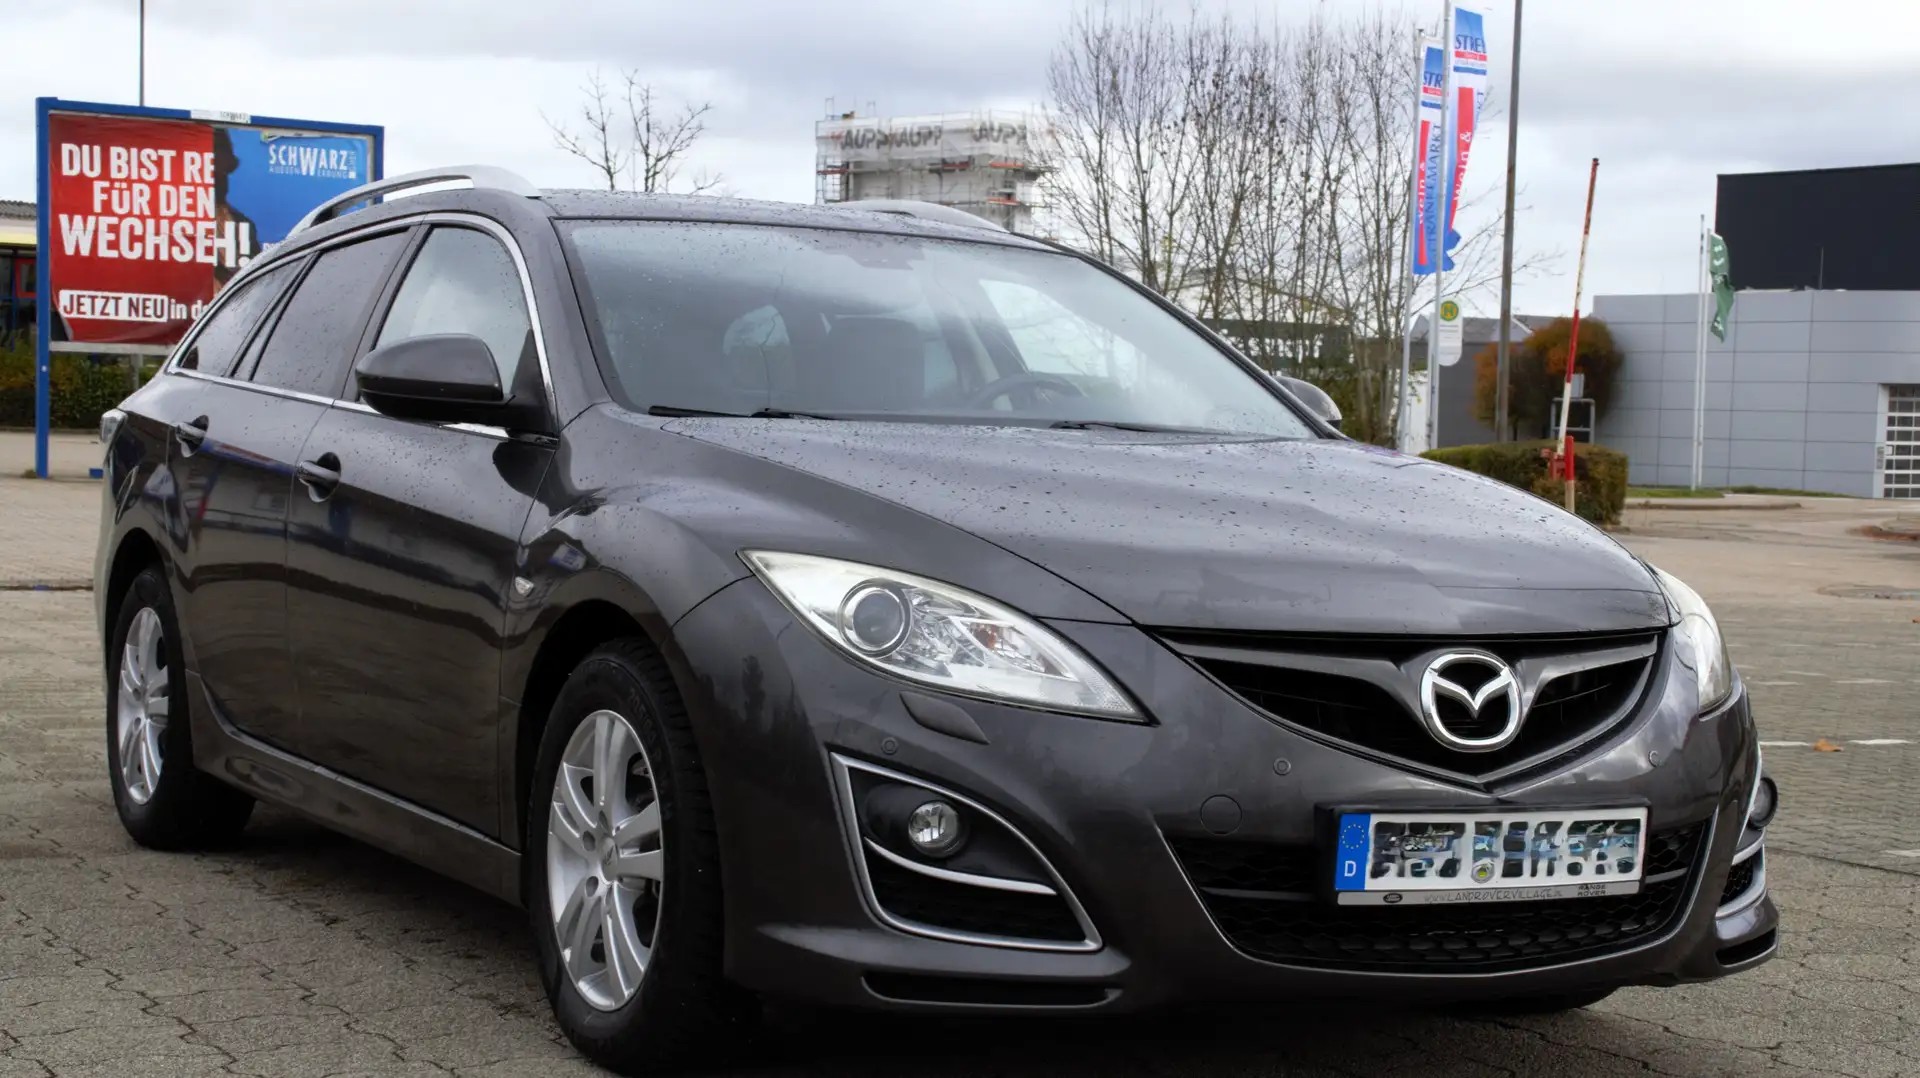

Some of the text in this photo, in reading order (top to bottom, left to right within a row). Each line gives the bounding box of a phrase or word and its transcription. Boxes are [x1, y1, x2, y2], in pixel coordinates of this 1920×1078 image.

[61, 143, 215, 184] DU BIST RE
[269, 144, 348, 176] SCHWARZ
[159, 184, 215, 218] DEN
[64, 294, 122, 317] JETZT
[128, 297, 165, 318] NEU
[170, 299, 185, 318] in
[1344, 860, 1356, 877] D
[1578, 883, 1606, 891] RANGE
